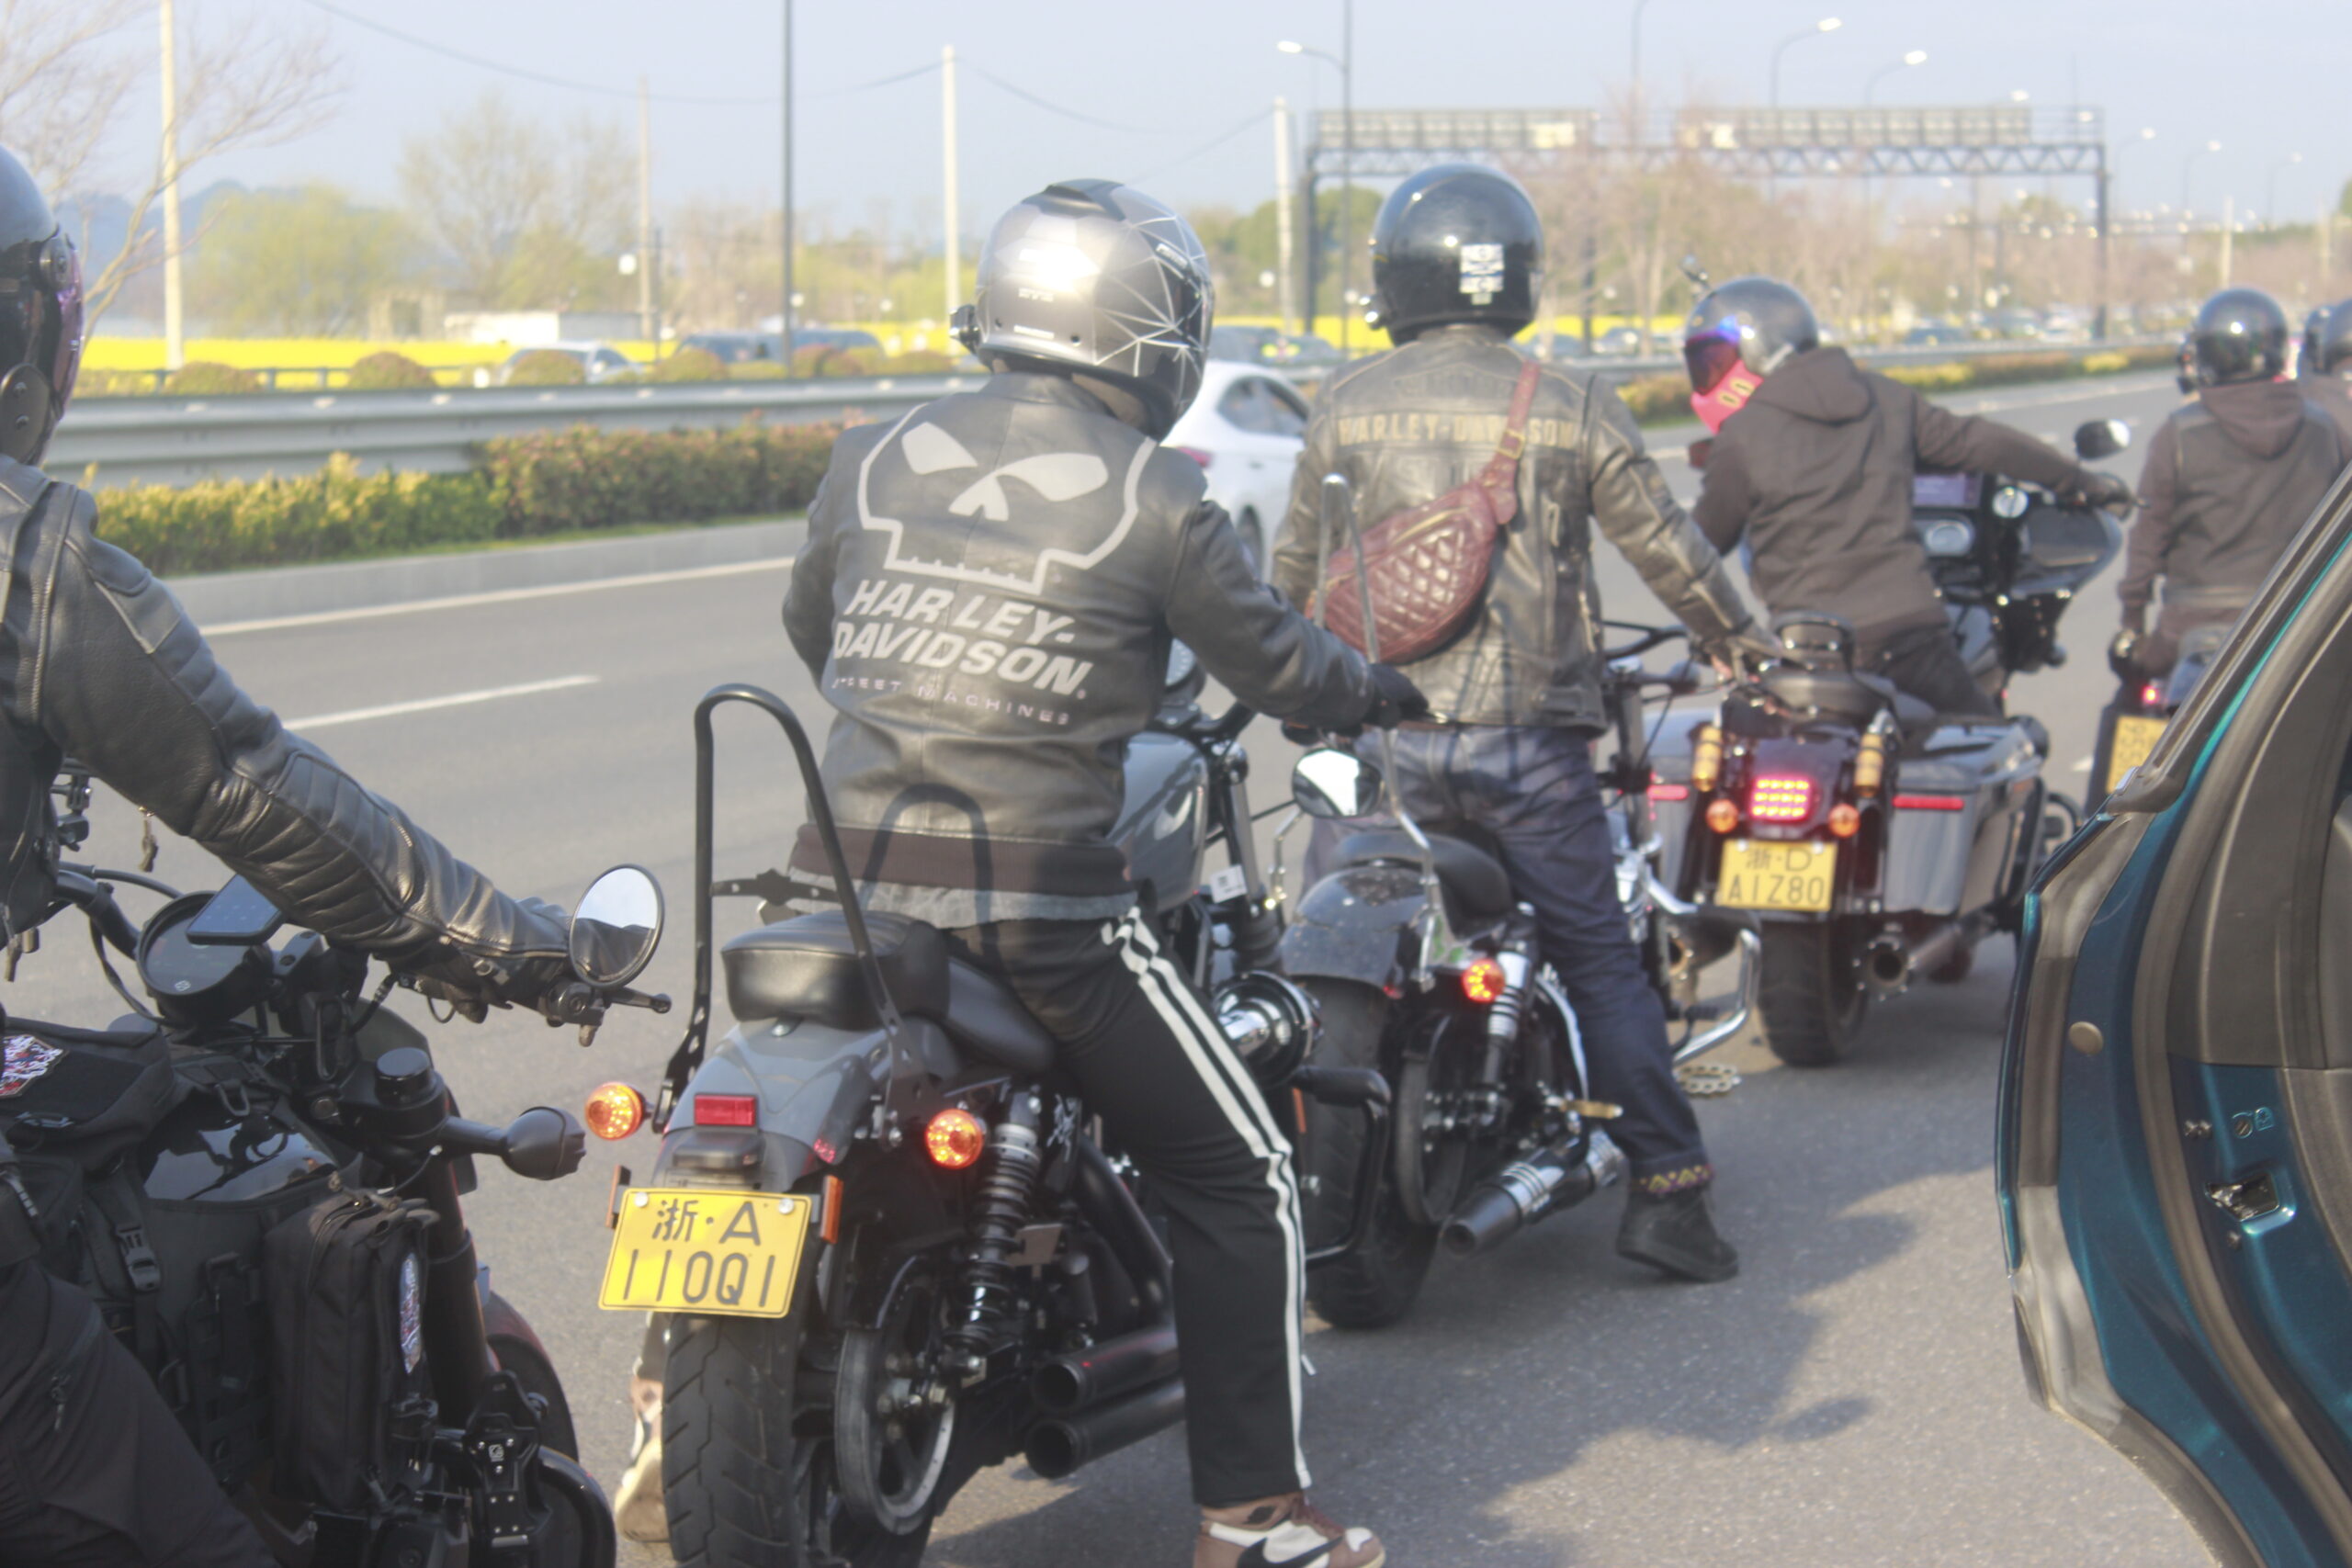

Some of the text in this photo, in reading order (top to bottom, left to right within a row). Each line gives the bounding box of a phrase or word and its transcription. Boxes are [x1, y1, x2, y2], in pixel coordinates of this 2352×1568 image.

[1337, 412, 1576, 448] HARLEY-DAVSON
[843, 580, 1076, 645] HARLEY-
[832, 622, 1093, 695] DAVIDSON
[1728, 874, 1825, 905] A1Z80
[651, 1198, 761, 1247] 浙·A
[622, 1248, 775, 1308] 110Q1
